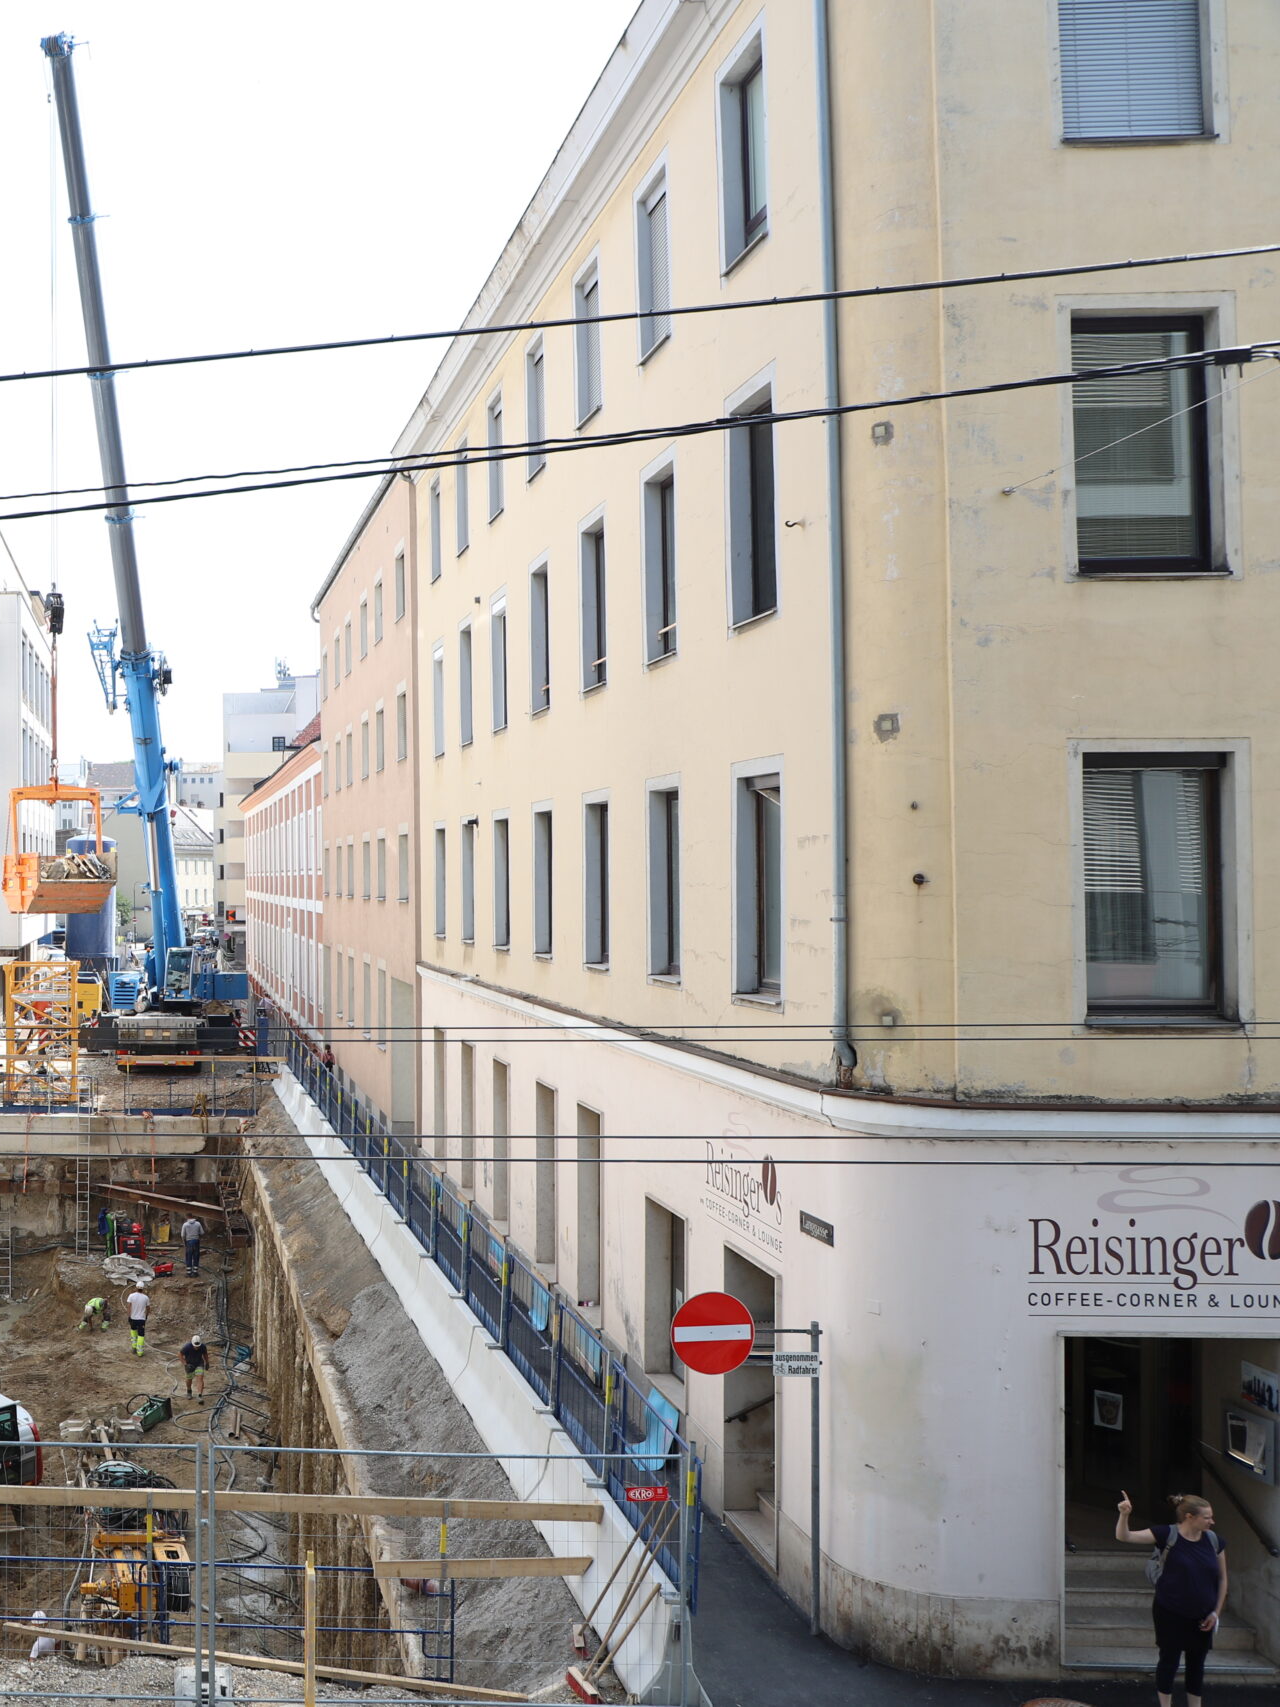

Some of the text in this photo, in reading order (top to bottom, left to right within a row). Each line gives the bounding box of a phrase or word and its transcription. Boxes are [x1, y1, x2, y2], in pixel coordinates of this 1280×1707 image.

[705, 1197, 750, 1233] COFFEE-CORNER
[758, 1228, 783, 1254] LOUNGE
[802, 1214, 829, 1239] Langgasse
[1028, 1292, 1198, 1308] COFFEE-CORNER
[1208, 1293, 1220, 1308] &
[775, 1354, 818, 1363] ausgenommen
[788, 1364, 818, 1375] Radfahrer
[630, 1489, 652, 1499] EKRO
